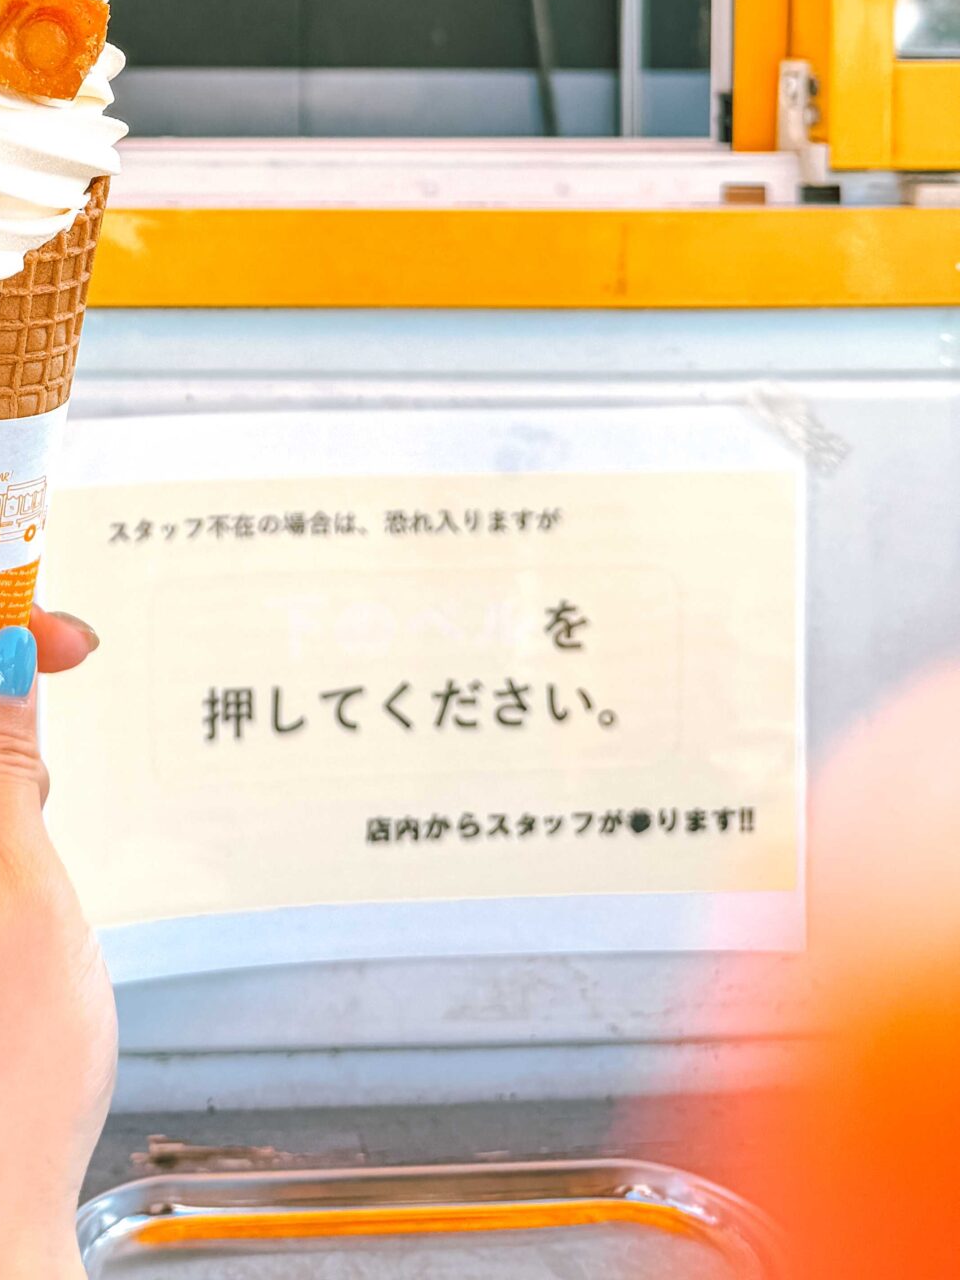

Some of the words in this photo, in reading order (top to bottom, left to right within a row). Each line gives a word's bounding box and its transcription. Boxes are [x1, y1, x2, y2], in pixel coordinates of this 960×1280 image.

[544, 599, 589, 651] を
[202, 677, 618, 742] 押してください。
[366, 806, 755, 843] 店内からスタッフがります!!
